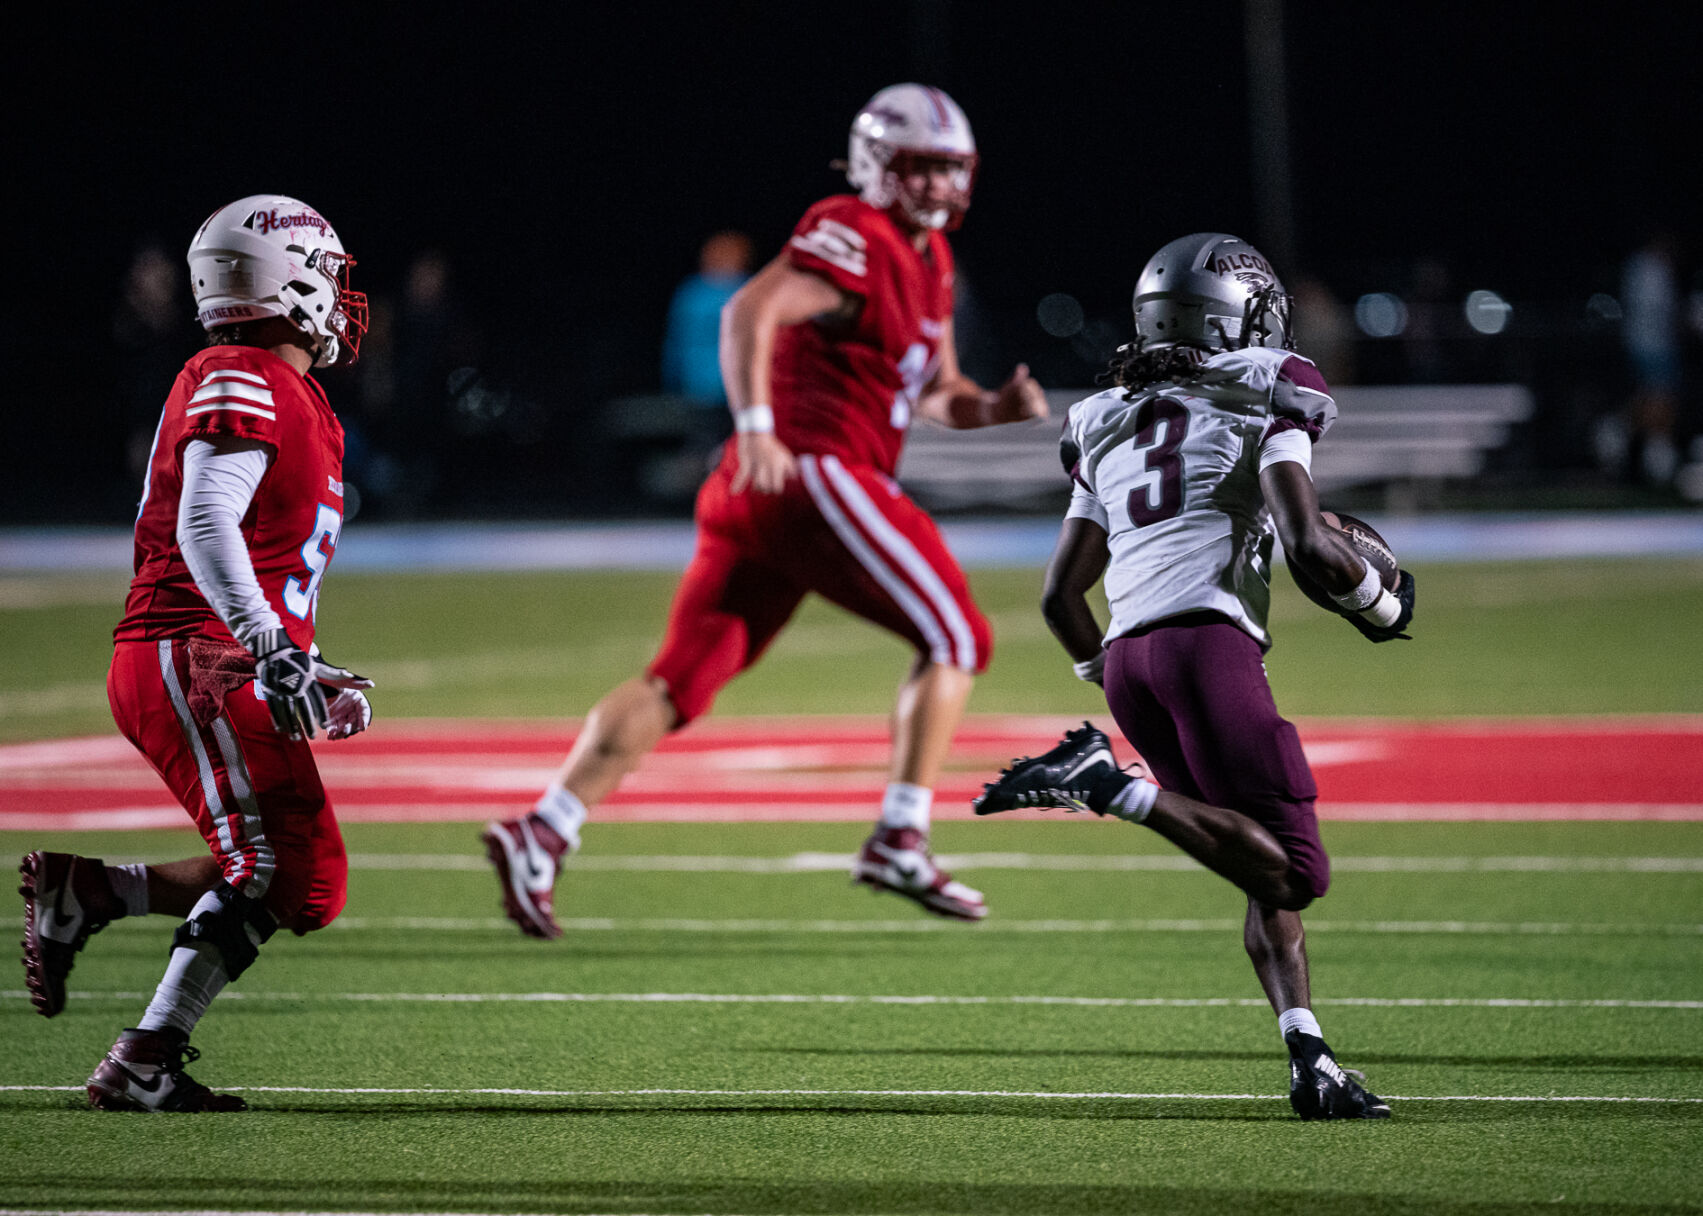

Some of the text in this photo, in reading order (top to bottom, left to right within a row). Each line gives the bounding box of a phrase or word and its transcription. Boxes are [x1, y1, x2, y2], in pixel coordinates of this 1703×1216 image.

[1126, 396, 1191, 528] 3
[282, 502, 343, 626] 5
[1314, 1053, 1347, 1088] NIKE
